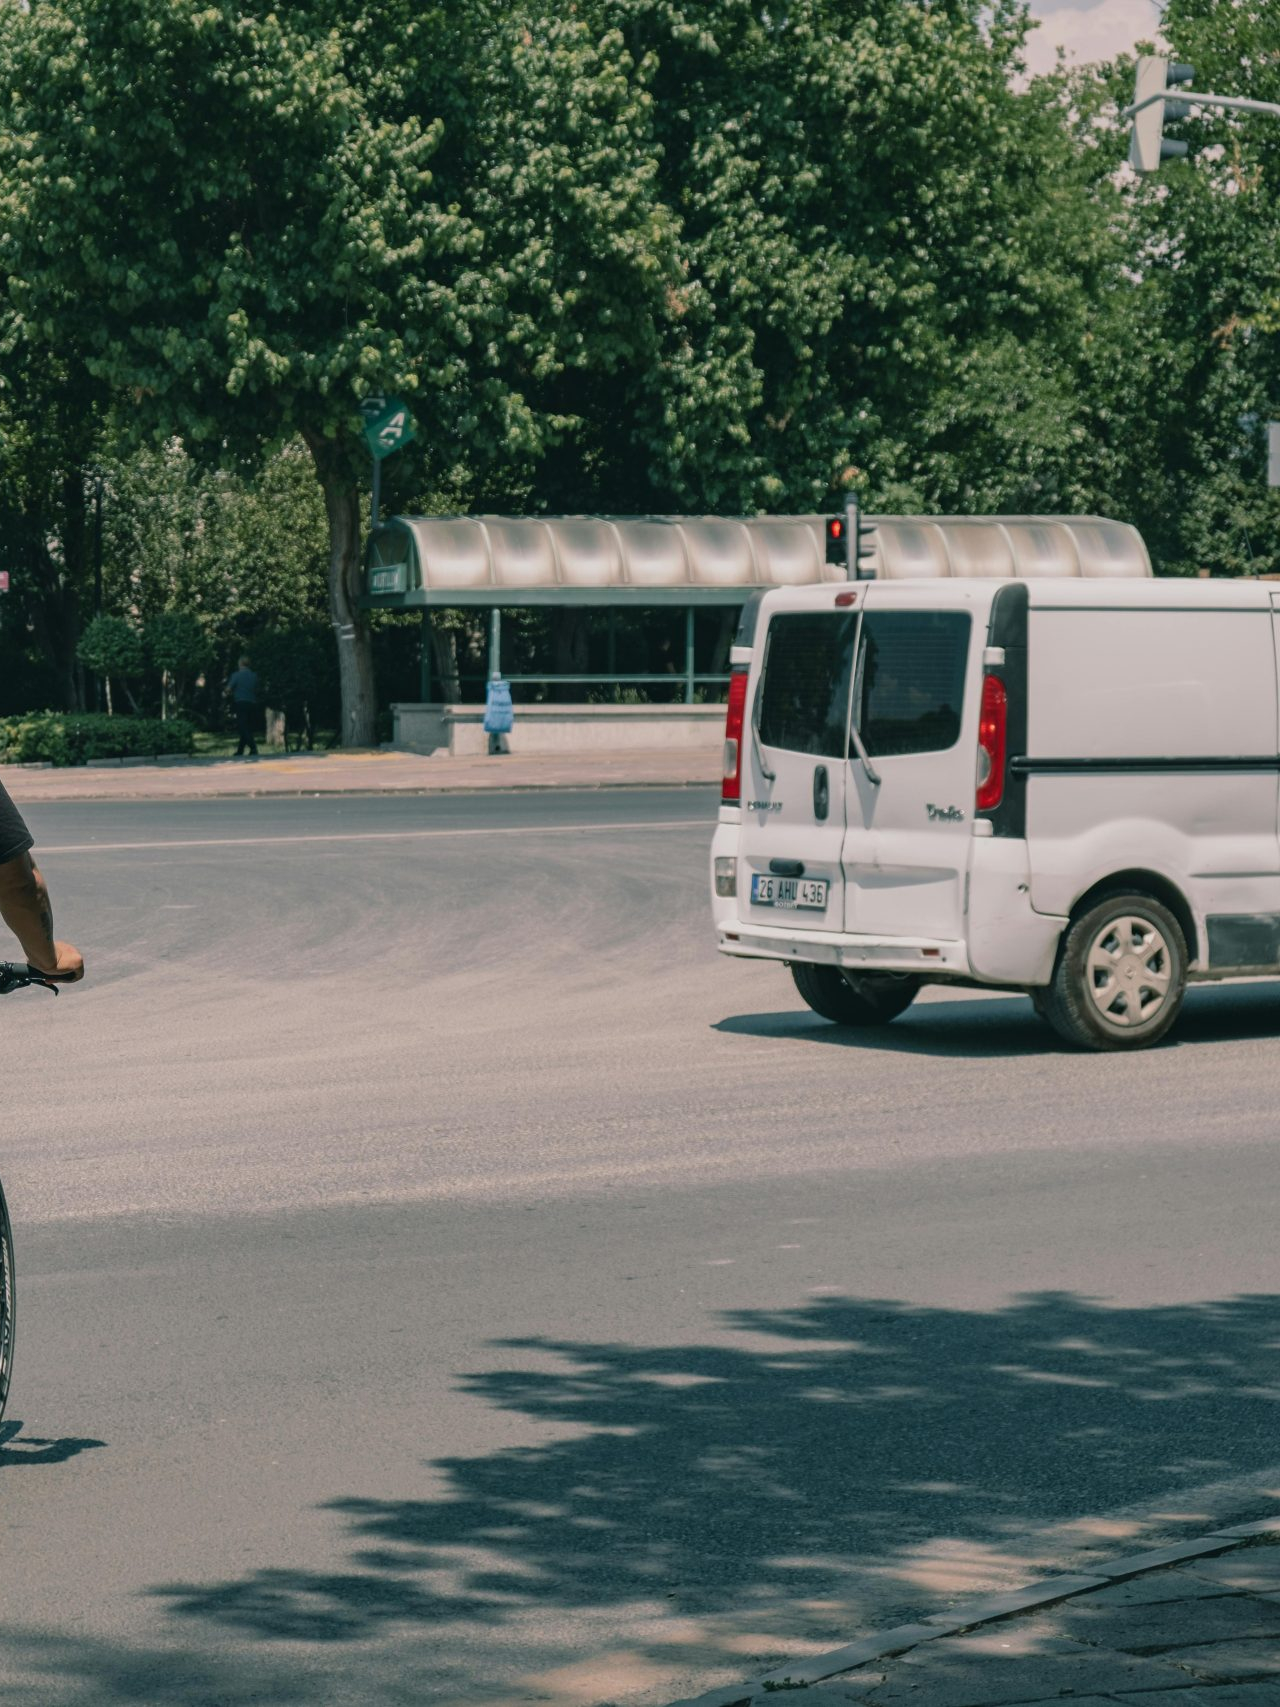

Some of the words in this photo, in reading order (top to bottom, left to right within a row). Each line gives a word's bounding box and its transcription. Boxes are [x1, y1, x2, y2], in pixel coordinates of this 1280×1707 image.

[760, 880, 774, 899] 26
[778, 881, 798, 900] AHU
[803, 883, 823, 903] 436
